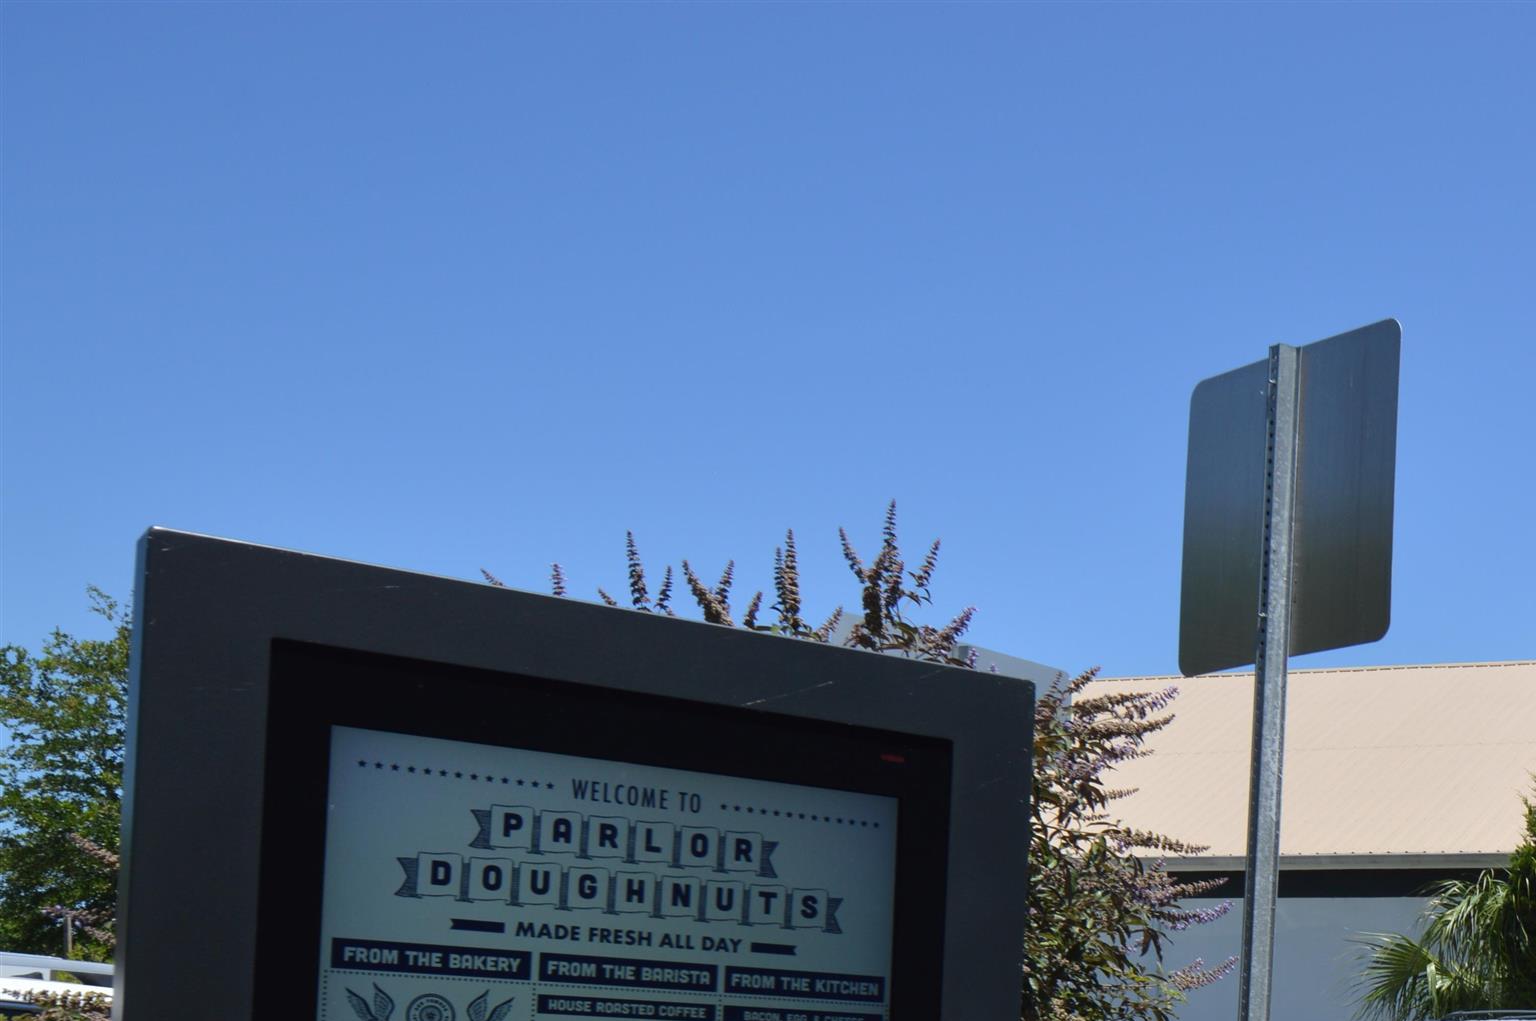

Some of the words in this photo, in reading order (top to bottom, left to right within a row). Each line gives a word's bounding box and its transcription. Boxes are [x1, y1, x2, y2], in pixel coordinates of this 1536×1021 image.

[570, 777, 669, 810] WELCOME
[676, 790, 702, 814] TO
[502, 812, 753, 862] PARLOR
[430, 860, 819, 919] DOUGHNUTS
[515, 921, 580, 941] MADE
[588, 926, 652, 947] FRESH
[658, 932, 695, 950] ALL
[701, 935, 742, 953] DAY
[343, 945, 399, 965] FROM
[404, 950, 443, 968] THE
[448, 953, 521, 972] BAKERY
[547, 960, 596, 978] FROM
[601, 964, 636, 980] THE
[641, 966, 710, 985] BARISTA
[730, 972, 775, 989] FROM
[779, 976, 810, 991] THE
[815, 978, 878, 996] KITCHEN
[547, 998, 592, 1012] HOUSE
[595, 1001, 655, 1016] ROASTED
[658, 1005, 706, 1018] COFFEE
